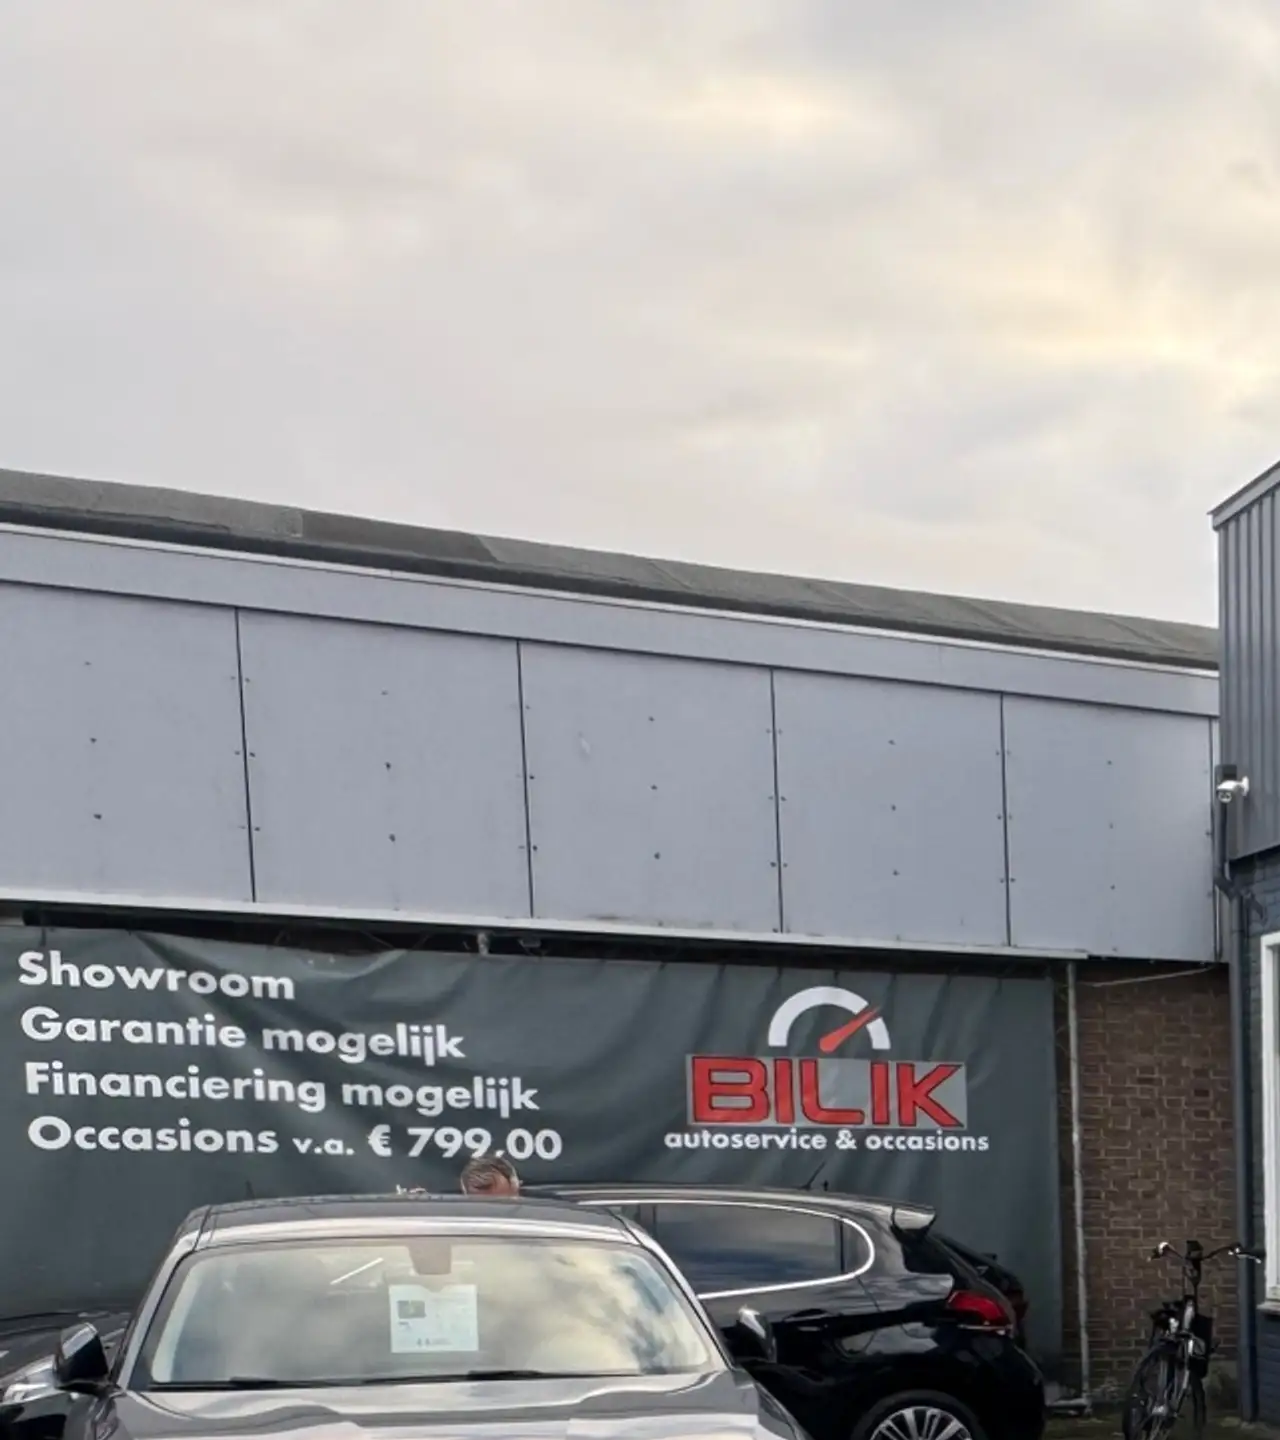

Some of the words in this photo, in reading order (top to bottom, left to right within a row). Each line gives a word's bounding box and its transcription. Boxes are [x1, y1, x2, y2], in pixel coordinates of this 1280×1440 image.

[18, 950, 295, 1000] Showroom
[20, 1006, 247, 1048] Garantie
[262, 1022, 466, 1067] mogelijk
[25, 1060, 326, 1113] Financiering
[342, 1076, 540, 1118] mogelijk
[692, 1056, 964, 1127] BILIK
[28, 1115, 279, 1153] Occasions
[292, 1137, 354, 1155] v.a.
[368, 1124, 392, 1157] €
[664, 1128, 827, 1150] autoservice
[835, 1130, 857, 1150] &
[865, 1130, 989, 1152] occasions
